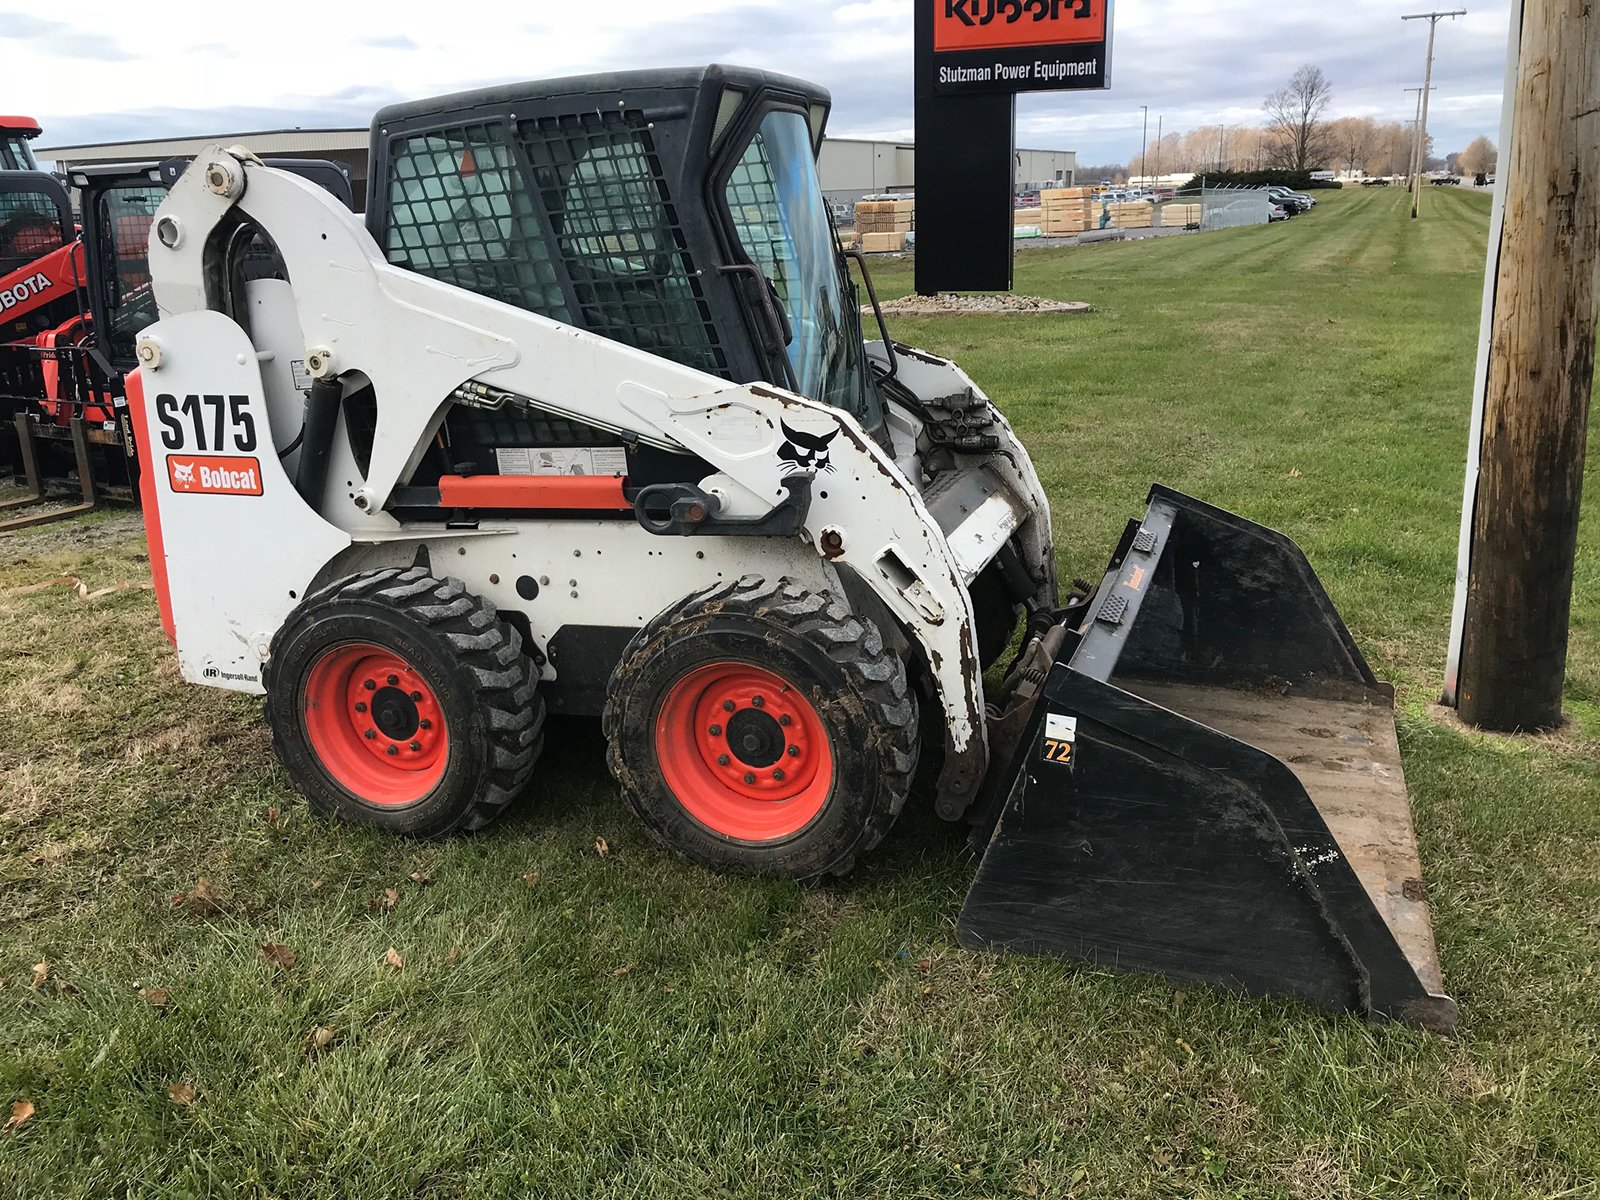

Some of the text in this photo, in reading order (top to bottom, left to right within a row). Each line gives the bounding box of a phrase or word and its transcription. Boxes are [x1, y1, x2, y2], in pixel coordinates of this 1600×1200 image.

[939, 58, 1097, 83] Stutzman Power Equipment
[0, 272, 52, 313] BOTA
[156, 394, 257, 452] S175
[199, 466, 257, 490] Bobcat
[1045, 740, 1071, 762] 72
